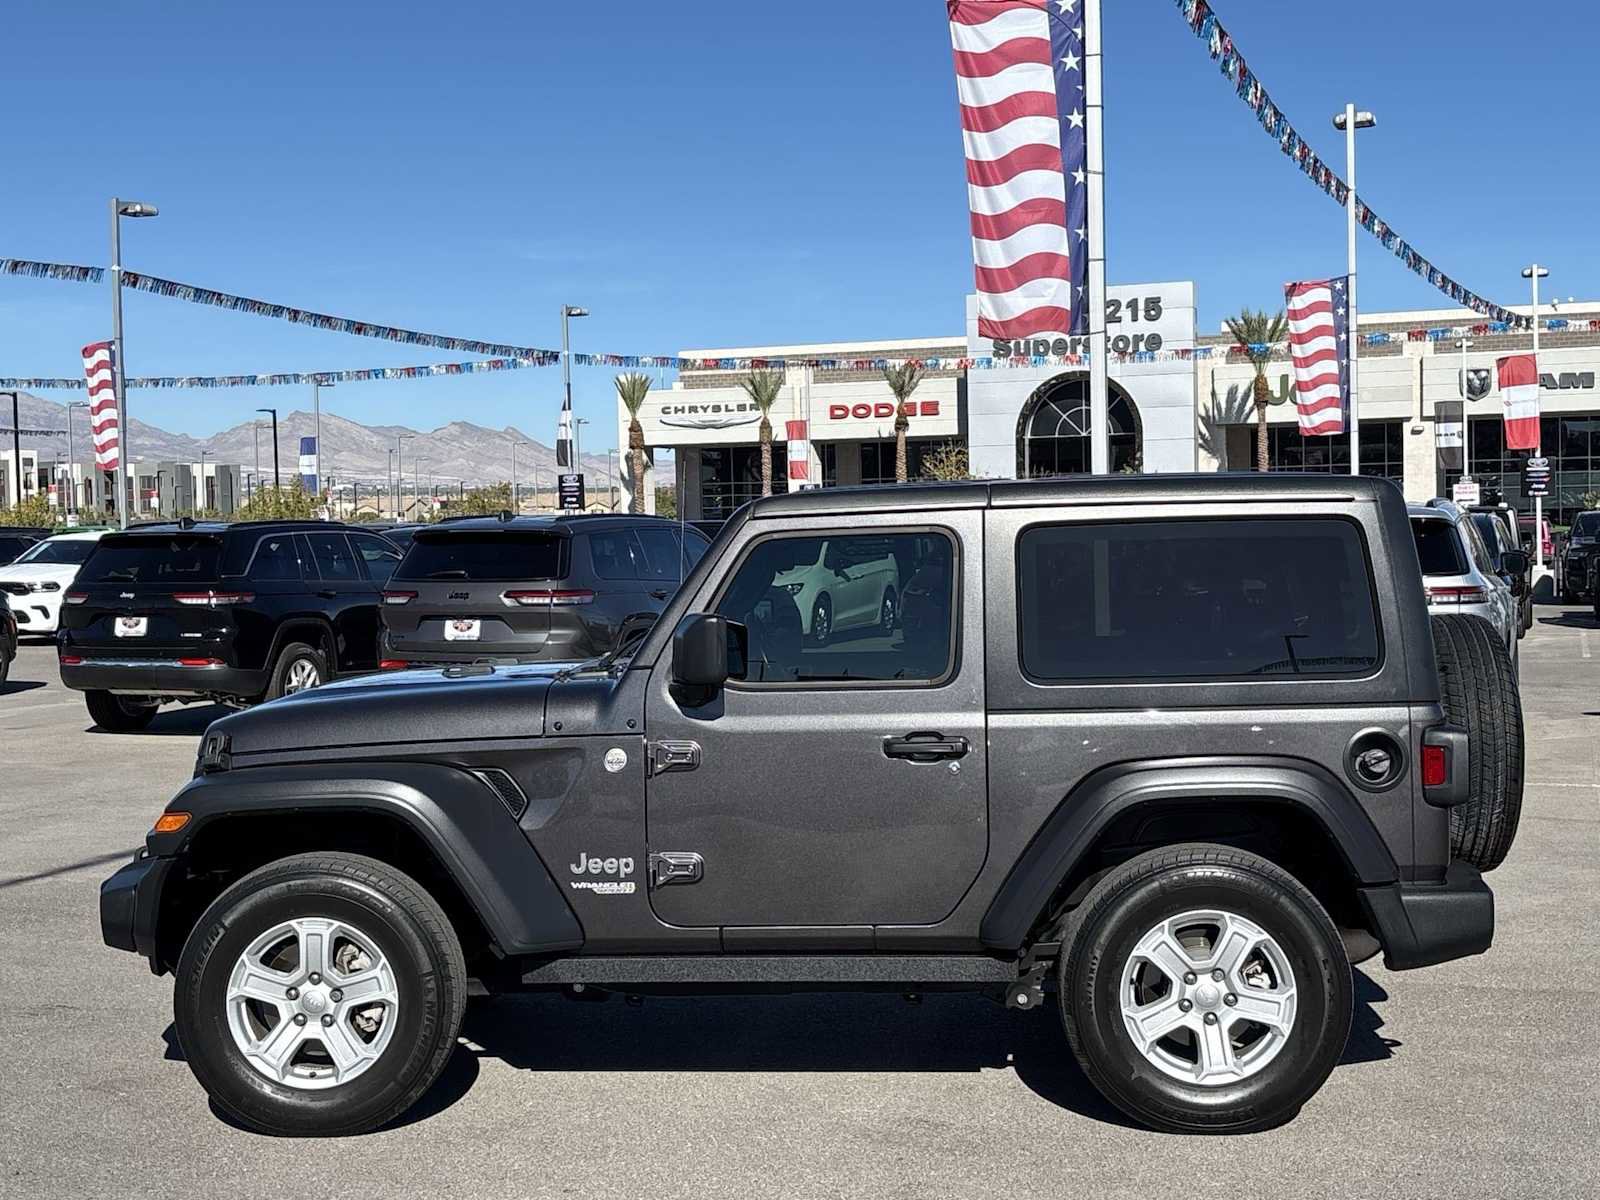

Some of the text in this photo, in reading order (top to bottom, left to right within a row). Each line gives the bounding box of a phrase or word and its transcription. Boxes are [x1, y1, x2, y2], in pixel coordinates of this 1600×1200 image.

[1106, 297, 1163, 323] 215
[661, 403, 761, 415] CHRYSLER
[570, 852, 635, 878] Jeep
